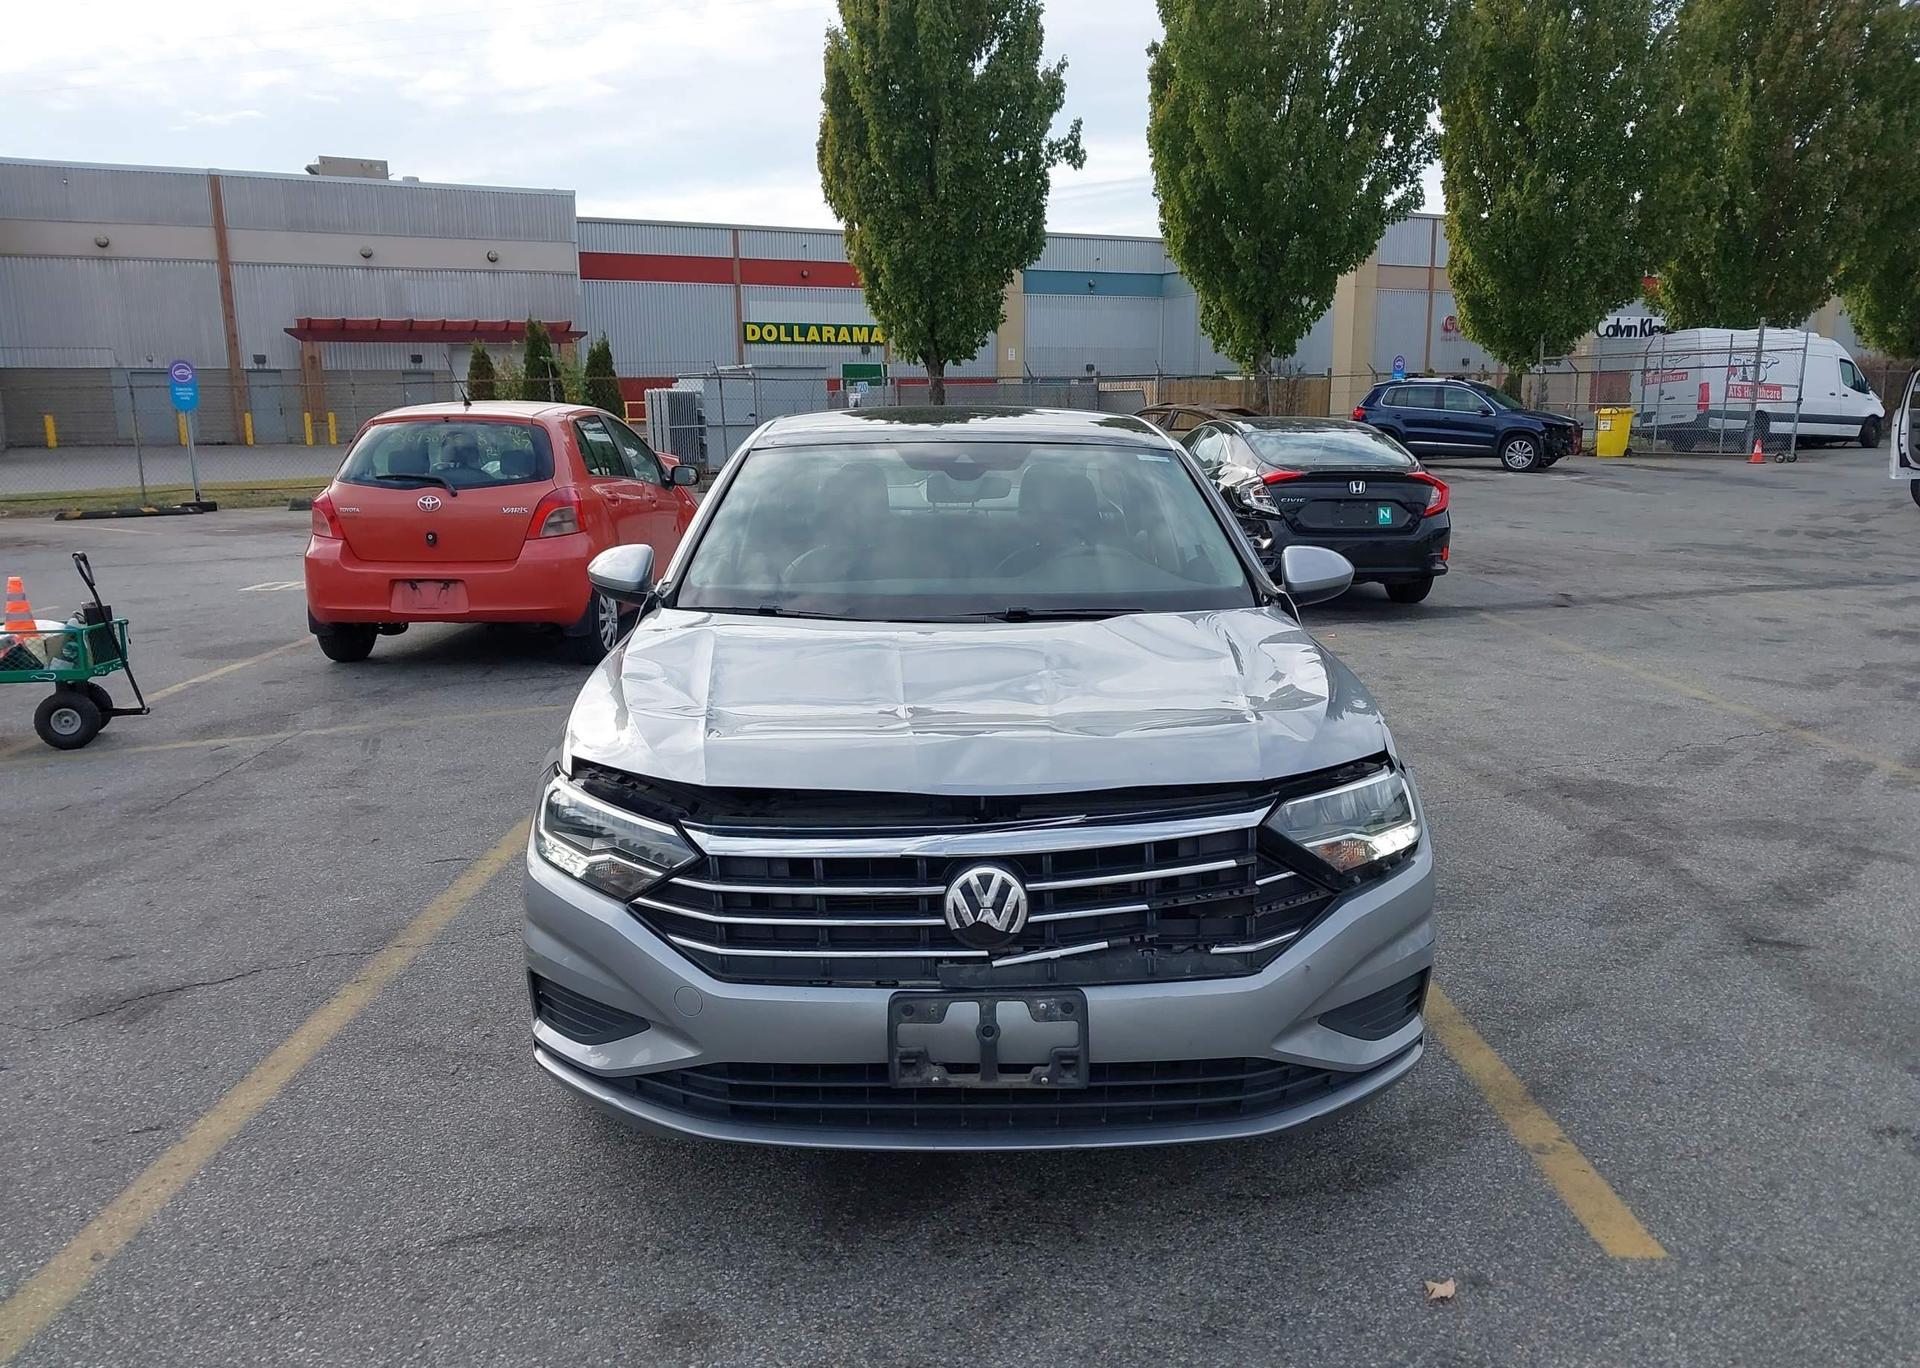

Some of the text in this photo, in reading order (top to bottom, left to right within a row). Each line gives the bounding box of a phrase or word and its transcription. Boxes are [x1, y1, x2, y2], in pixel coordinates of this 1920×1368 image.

[746, 324, 885, 343] DOLLARAMA
[1596, 318, 1638, 338] Calvin
[1728, 386, 1742, 398] ATS
[1380, 508, 1390, 519] N
